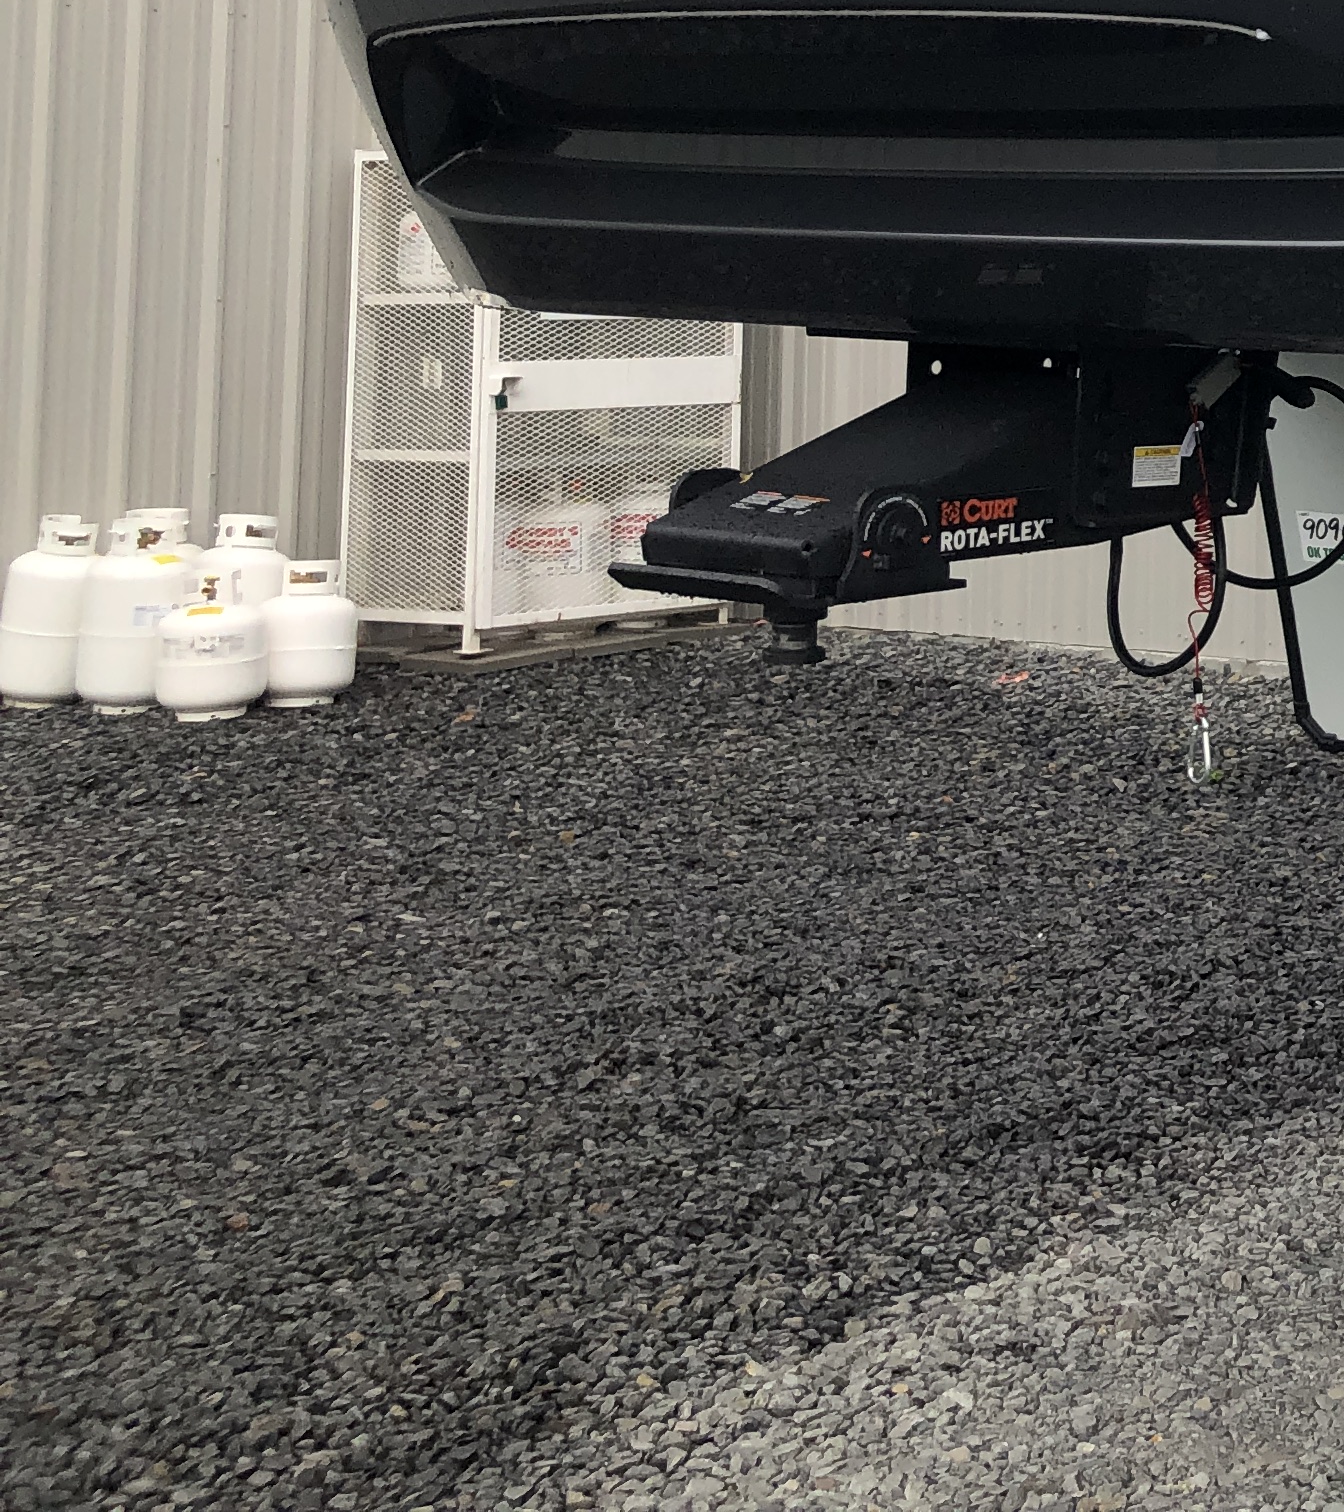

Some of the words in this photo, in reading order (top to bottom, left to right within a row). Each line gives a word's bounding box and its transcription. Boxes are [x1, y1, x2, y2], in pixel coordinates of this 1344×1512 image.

[963, 497, 1018, 523] CURT
[940, 519, 1045, 552] ROTA-FLEX
[1307, 546, 1321, 558] OK
